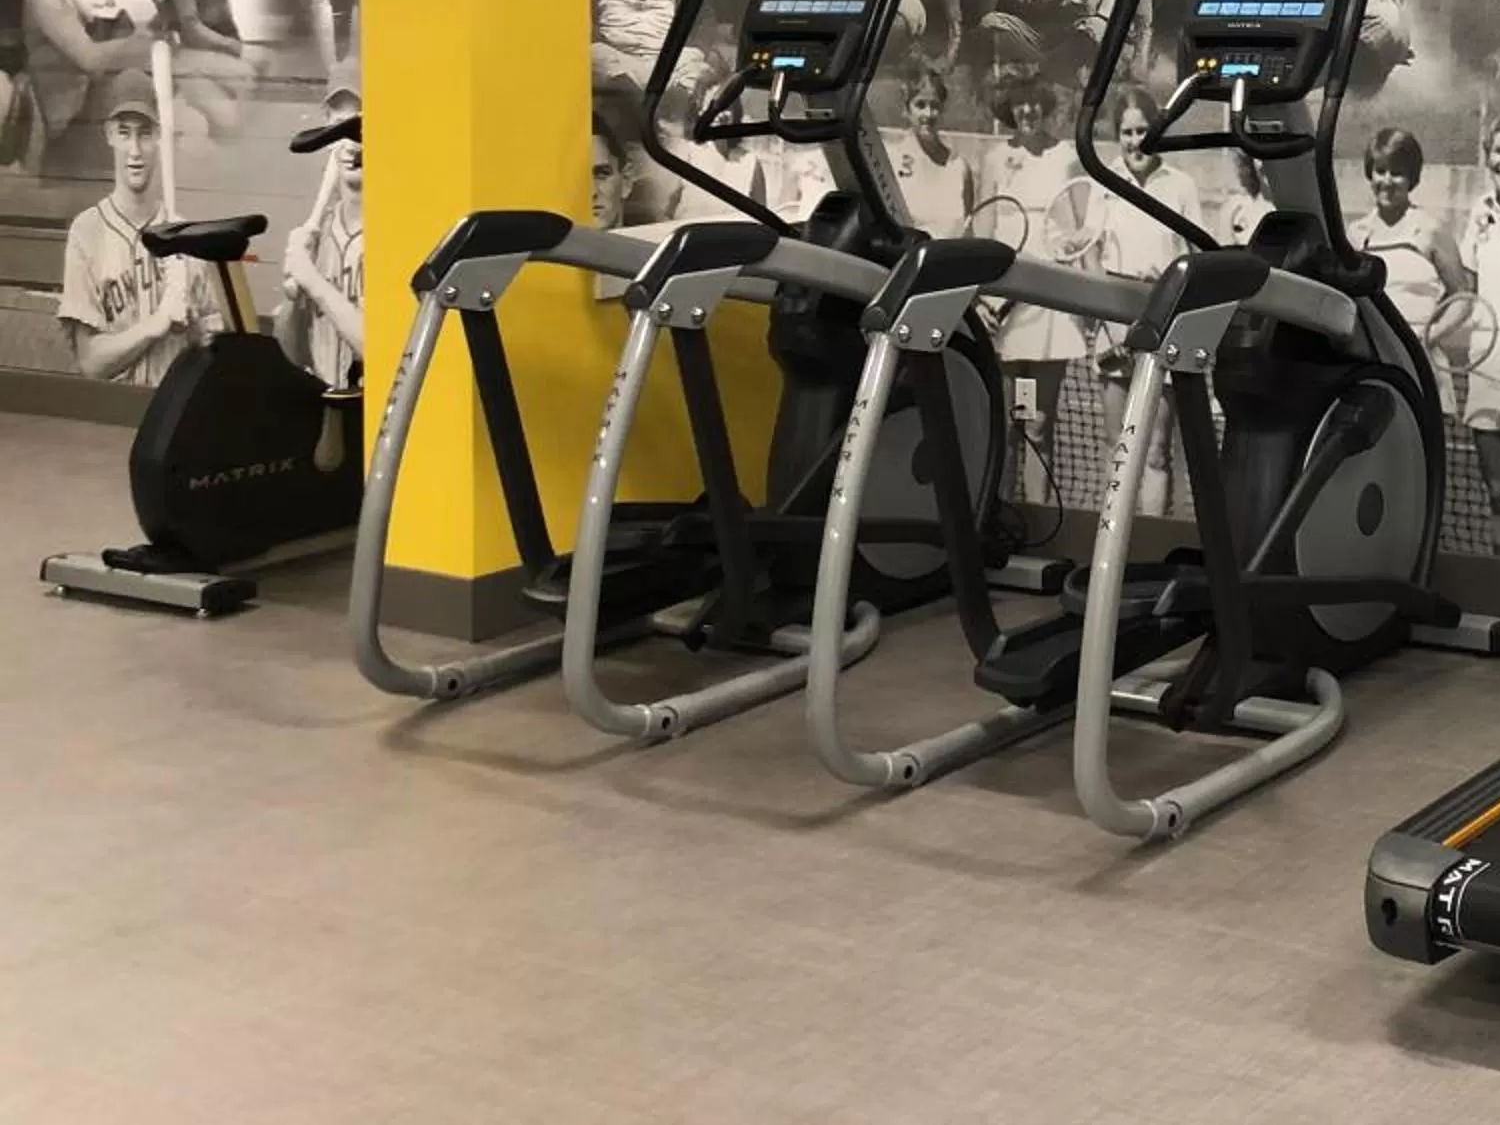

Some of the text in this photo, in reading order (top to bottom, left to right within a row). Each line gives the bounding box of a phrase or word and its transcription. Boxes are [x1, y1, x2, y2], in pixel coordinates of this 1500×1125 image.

[188, 456, 297, 491] MATRIX
[1099, 423, 1136, 531] MATRIX
[1436, 858, 1483, 937] MATR
